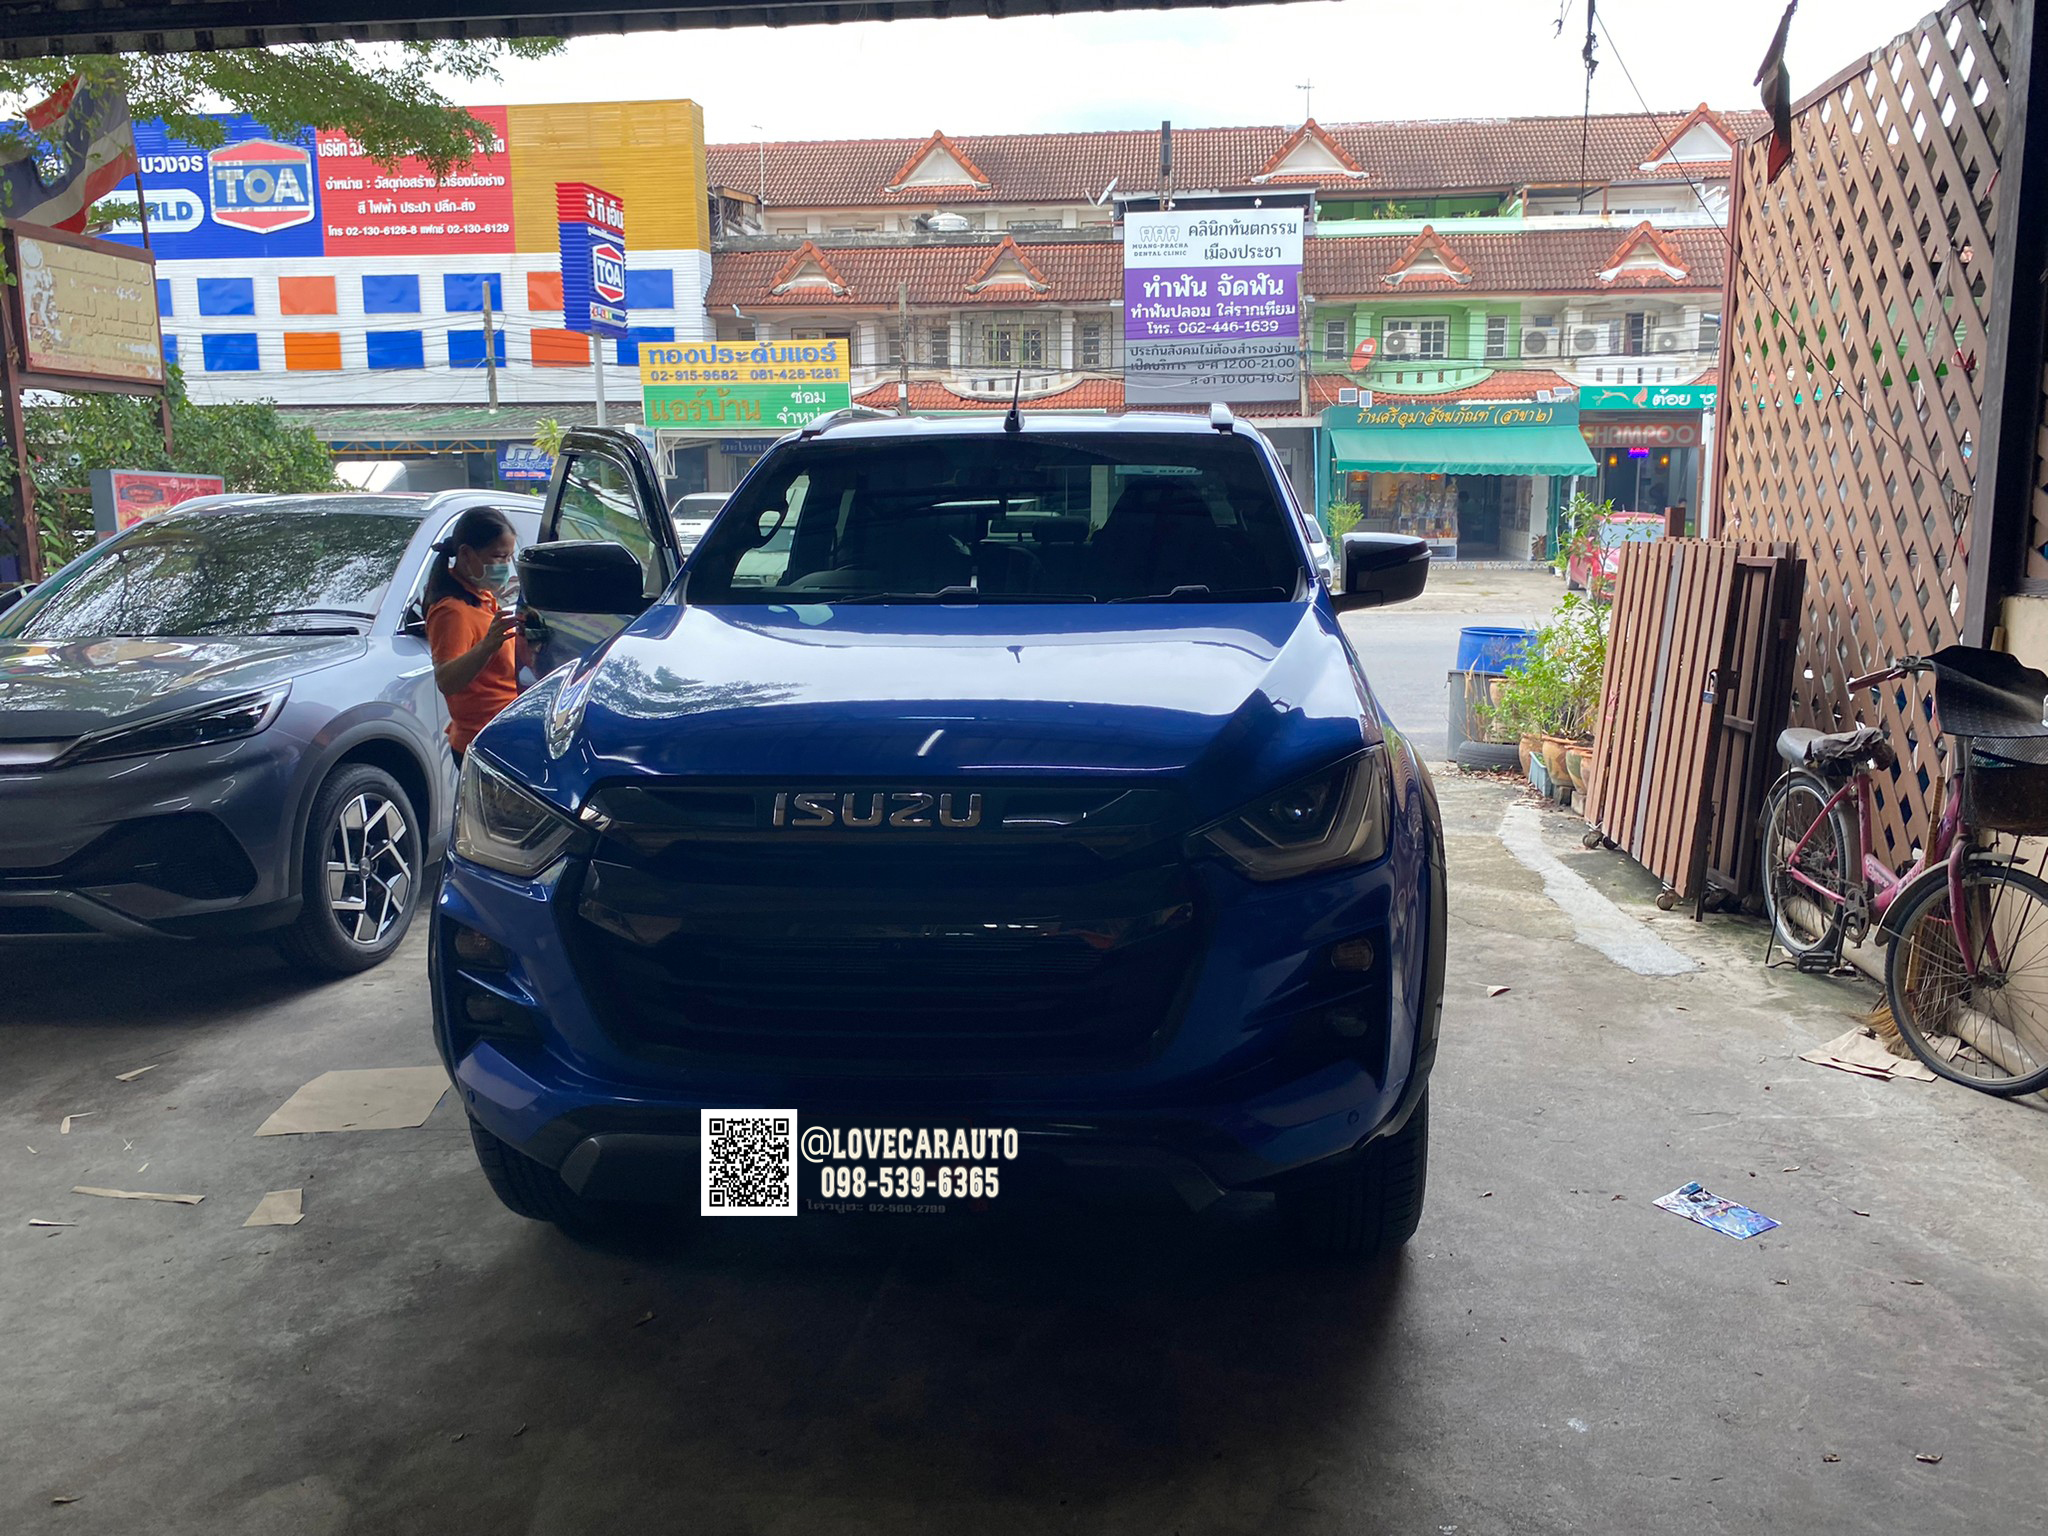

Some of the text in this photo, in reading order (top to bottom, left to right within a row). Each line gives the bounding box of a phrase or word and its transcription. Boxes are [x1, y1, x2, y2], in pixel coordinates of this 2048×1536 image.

[318, 138, 347, 157] บริษัท
[138, 155, 204, 174] บวงจร
[216, 168, 305, 204] TOA
[325, 176, 363, 190] จำหน่าย
[374, 174, 436, 192] วัสดุก่อสร้าง
[357, 200, 366, 214] สี
[369, 198, 397, 214] ไฟฟ้า
[400, 201, 431, 214] ประปา
[447, 223, 509, 234] 02-130-6129
[1188, 219, 1297, 237] คลินิกทันตกรรม
[1204, 243, 1281, 260] เมืองประชา
[597, 258, 622, 288] TOA
[1143, 272, 1284, 298] ทำฟัน จัดฟัน
[1131, 302, 1296, 319] ทำฟันปลอม ใส่รากเทียม
[1147, 320, 1279, 335] โทร. 062-446-1639
[648, 341, 838, 365] ทองประดับแอร์
[1223, 358, 1295, 370] 12.00-21.00
[651, 368, 840, 382] 02-915-9682 081-428-1281
[790, 385, 826, 404] ซ่อม
[1652, 388, 1691, 406] ต้อย
[651, 388, 761, 422] แอร์บ้าน
[1582, 424, 1694, 445] SHAMPOO
[772, 792, 982, 827] ISUZU
